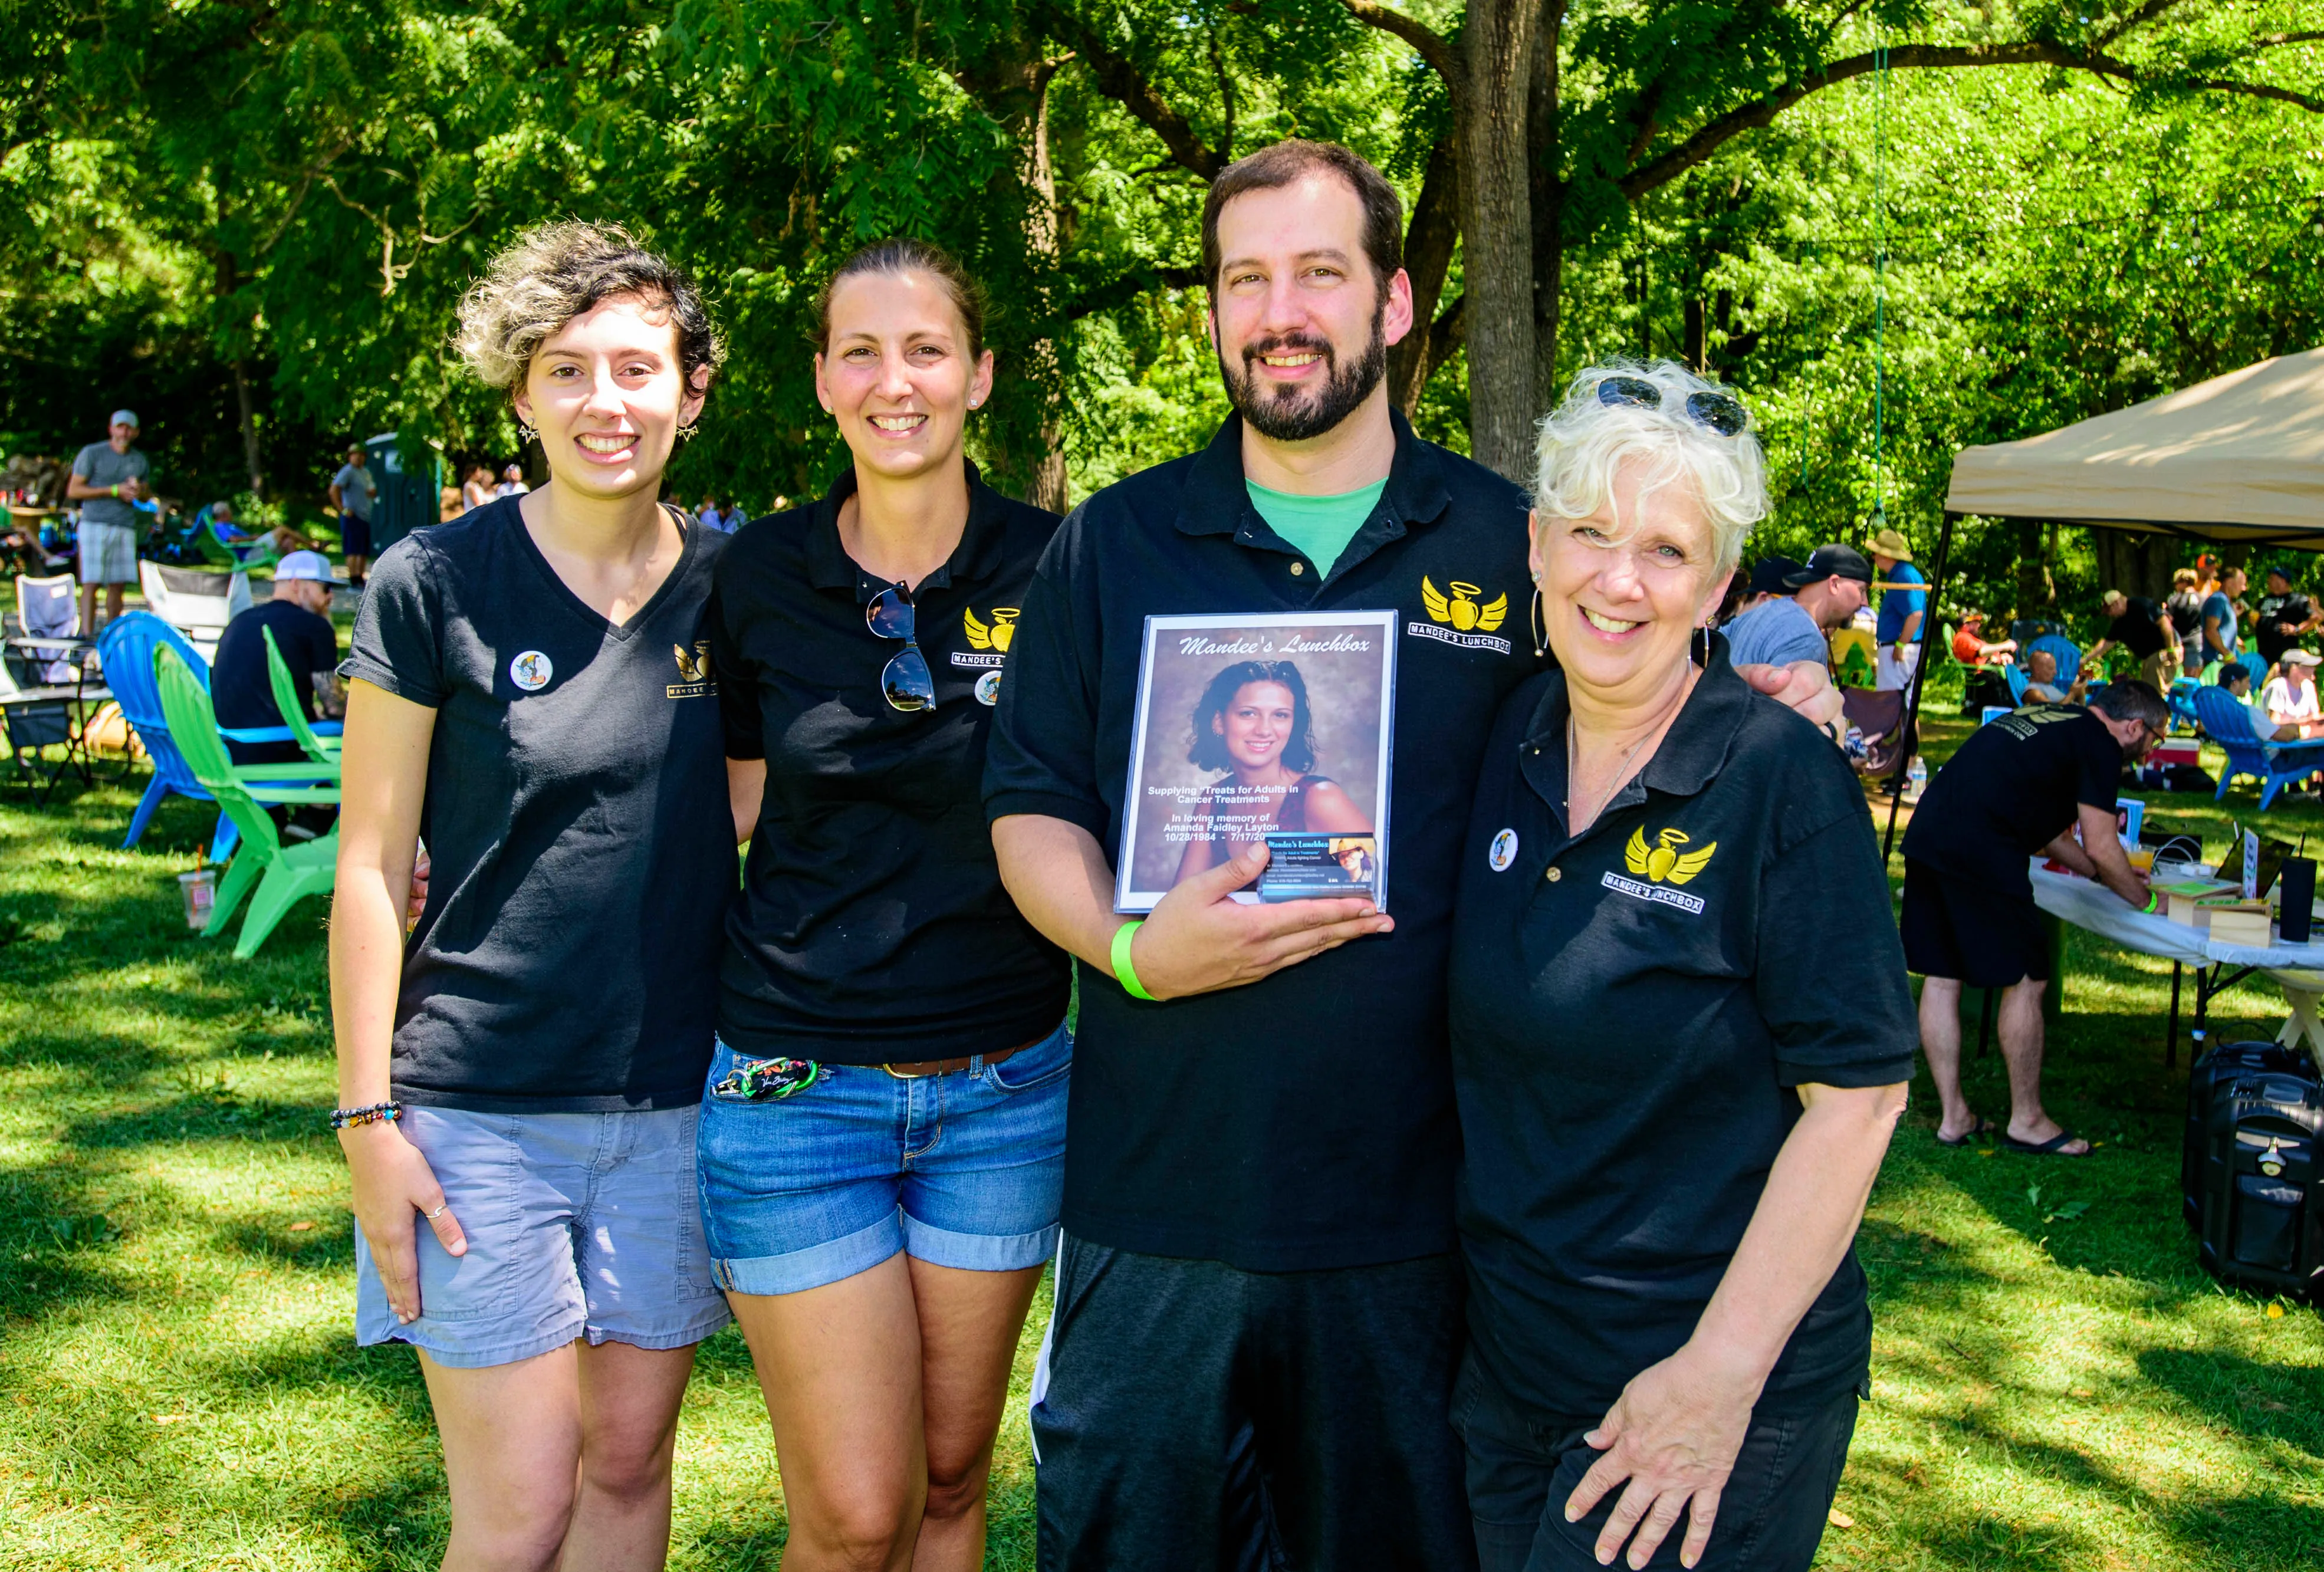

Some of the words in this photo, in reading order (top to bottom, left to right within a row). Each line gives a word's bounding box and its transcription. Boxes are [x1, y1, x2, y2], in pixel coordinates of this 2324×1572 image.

[1411, 625, 1458, 642] MANDEE'S
[1462, 636, 1509, 652] LUNCHBOX
[1179, 636, 1274, 656] Mandee's
[1278, 633, 1370, 653] Lunchbox
[954, 655, 1001, 665] MANDEE'S
[1148, 787, 1197, 796] Supplying
[1238, 785, 1253, 794] for
[1254, 785, 1286, 794] Adults
[1289, 785, 1299, 793] in
[1177, 795, 1212, 804] Cancer
[1215, 795, 1270, 803] Treatments
[1172, 814, 1182, 823] In
[1184, 814, 1214, 824] loving
[1217, 815, 1257, 824] memory
[1260, 813, 1271, 822] of
[1163, 823, 1204, 832] Amanda
[1207, 823, 1242, 833] Faidley
[1245, 823, 1279, 833] Layton
[1165, 833, 1216, 841] 10/28/1984
[1230, 833, 1266, 841] 7/17/20
[1605, 875, 1651, 897] MANDEE'S
